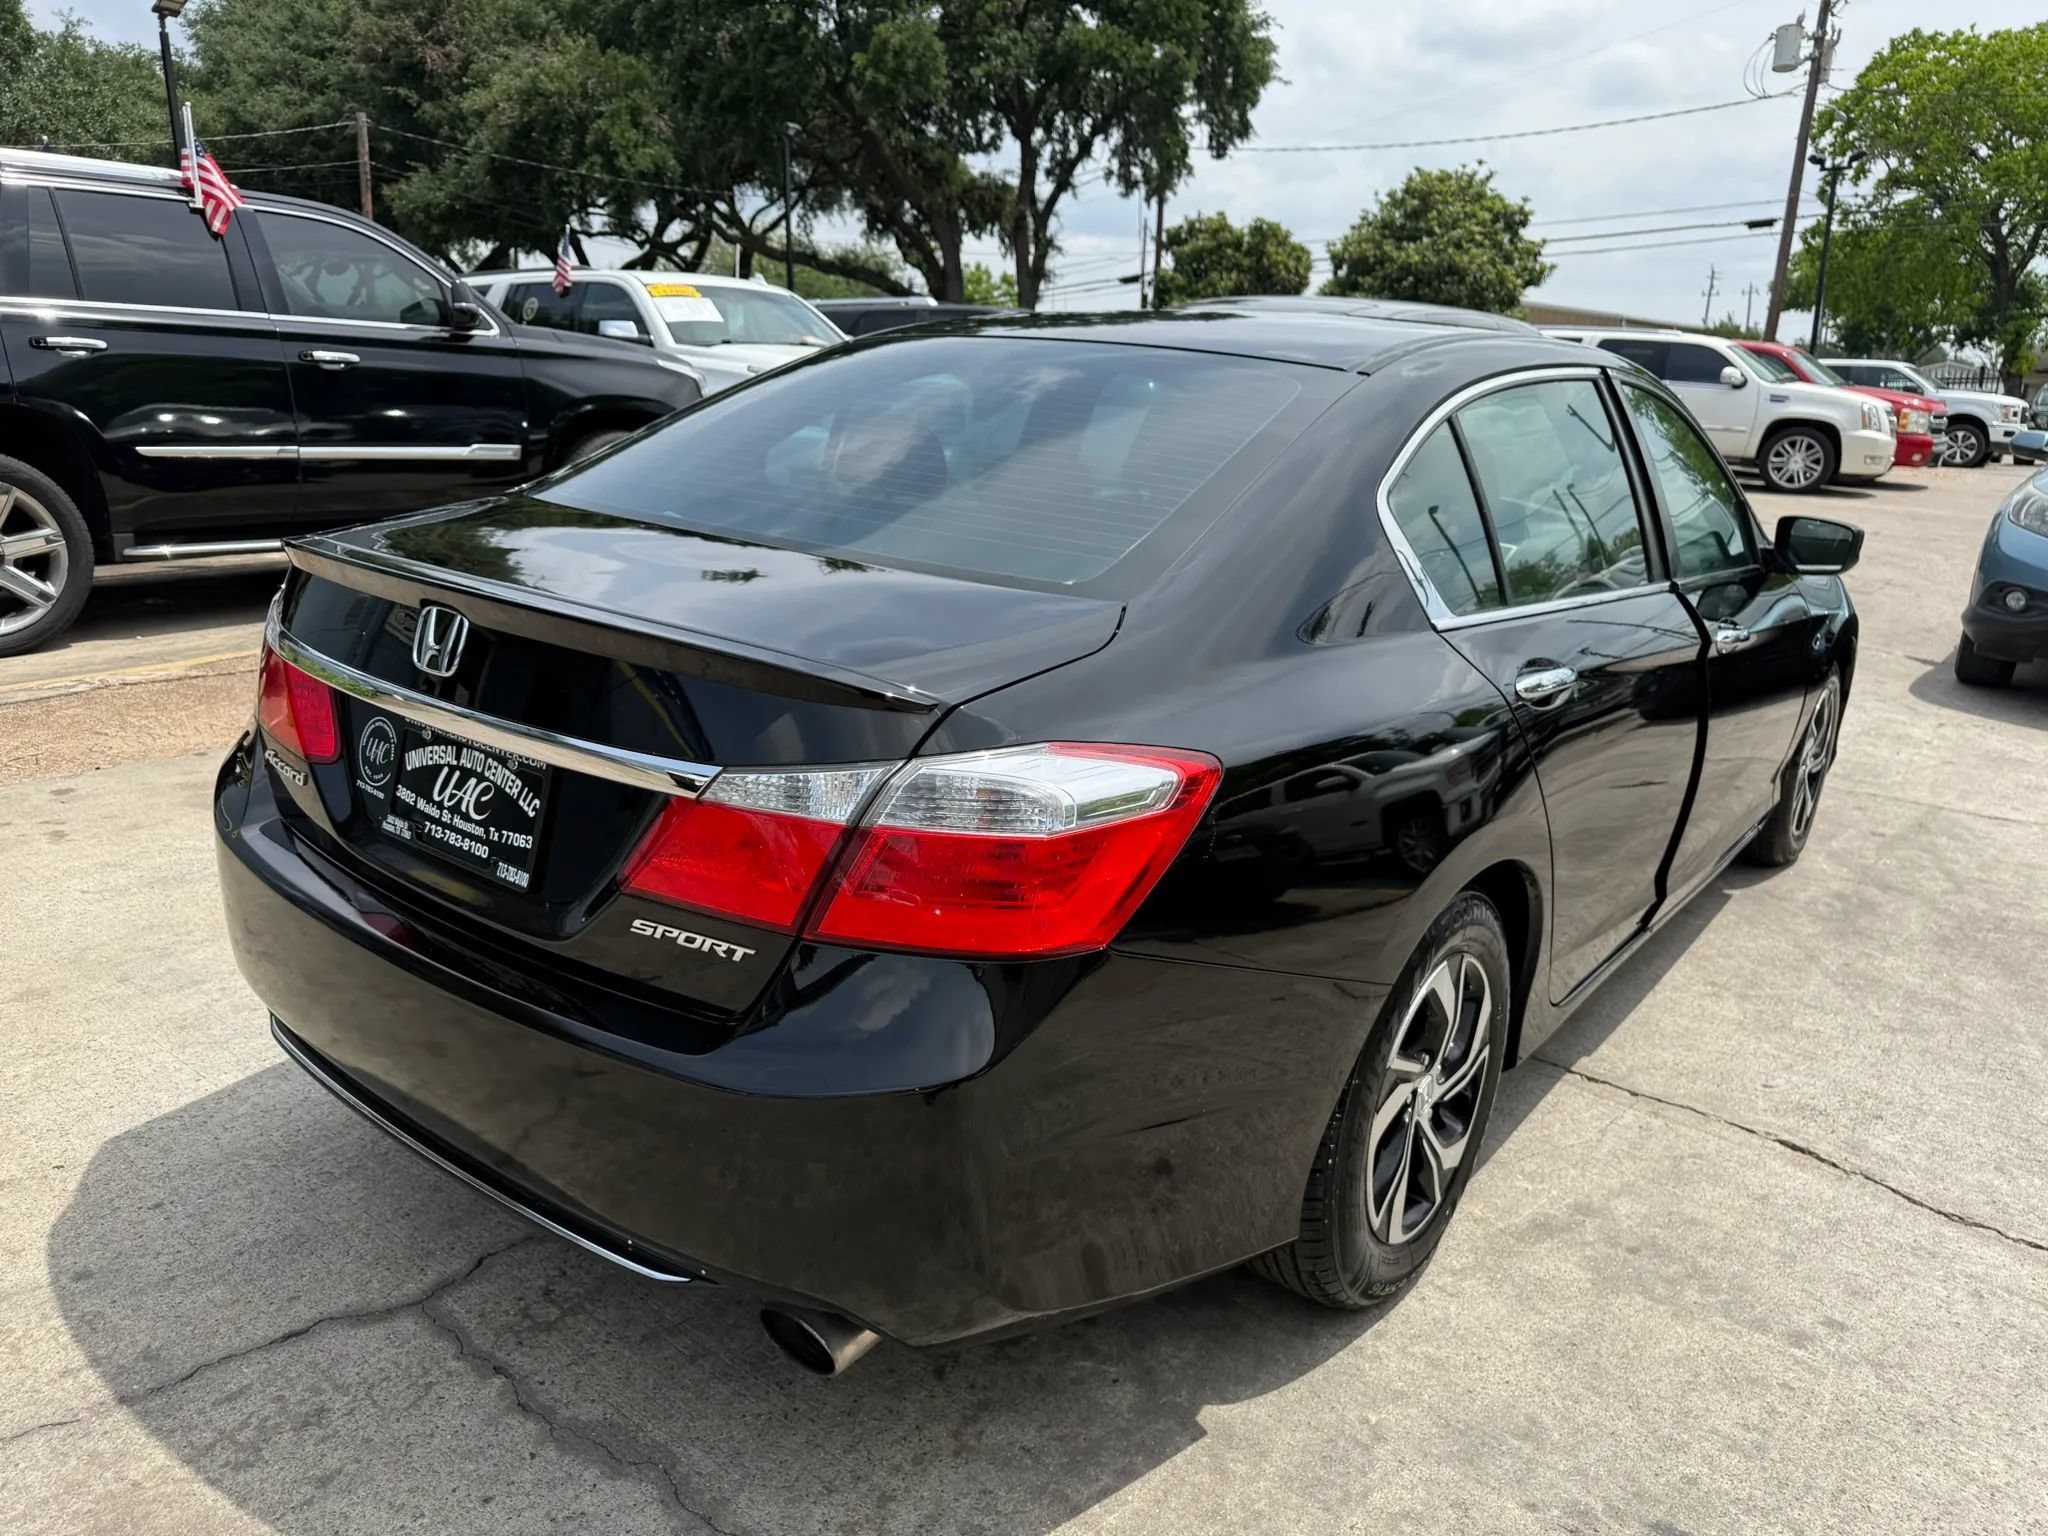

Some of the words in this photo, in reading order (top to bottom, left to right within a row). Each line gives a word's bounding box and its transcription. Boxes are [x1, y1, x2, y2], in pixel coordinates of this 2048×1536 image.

[264, 749, 304, 787] Accord
[405, 745, 458, 771] UNIVERSAL
[459, 747, 486, 773] AUTO
[484, 757, 522, 800] CENTER
[518, 787, 540, 818] LLC
[396, 784, 416, 806] 3802
[416, 796, 440, 819] Waldo
[441, 809, 452, 824] St
[452, 813, 487, 841] Houston,
[489, 826, 500, 842] Tx
[501, 830, 533, 849] 77063
[433, 766, 495, 820] UAC
[424, 821, 489, 859] 713-783-8100
[629, 918, 757, 962] SPORT
